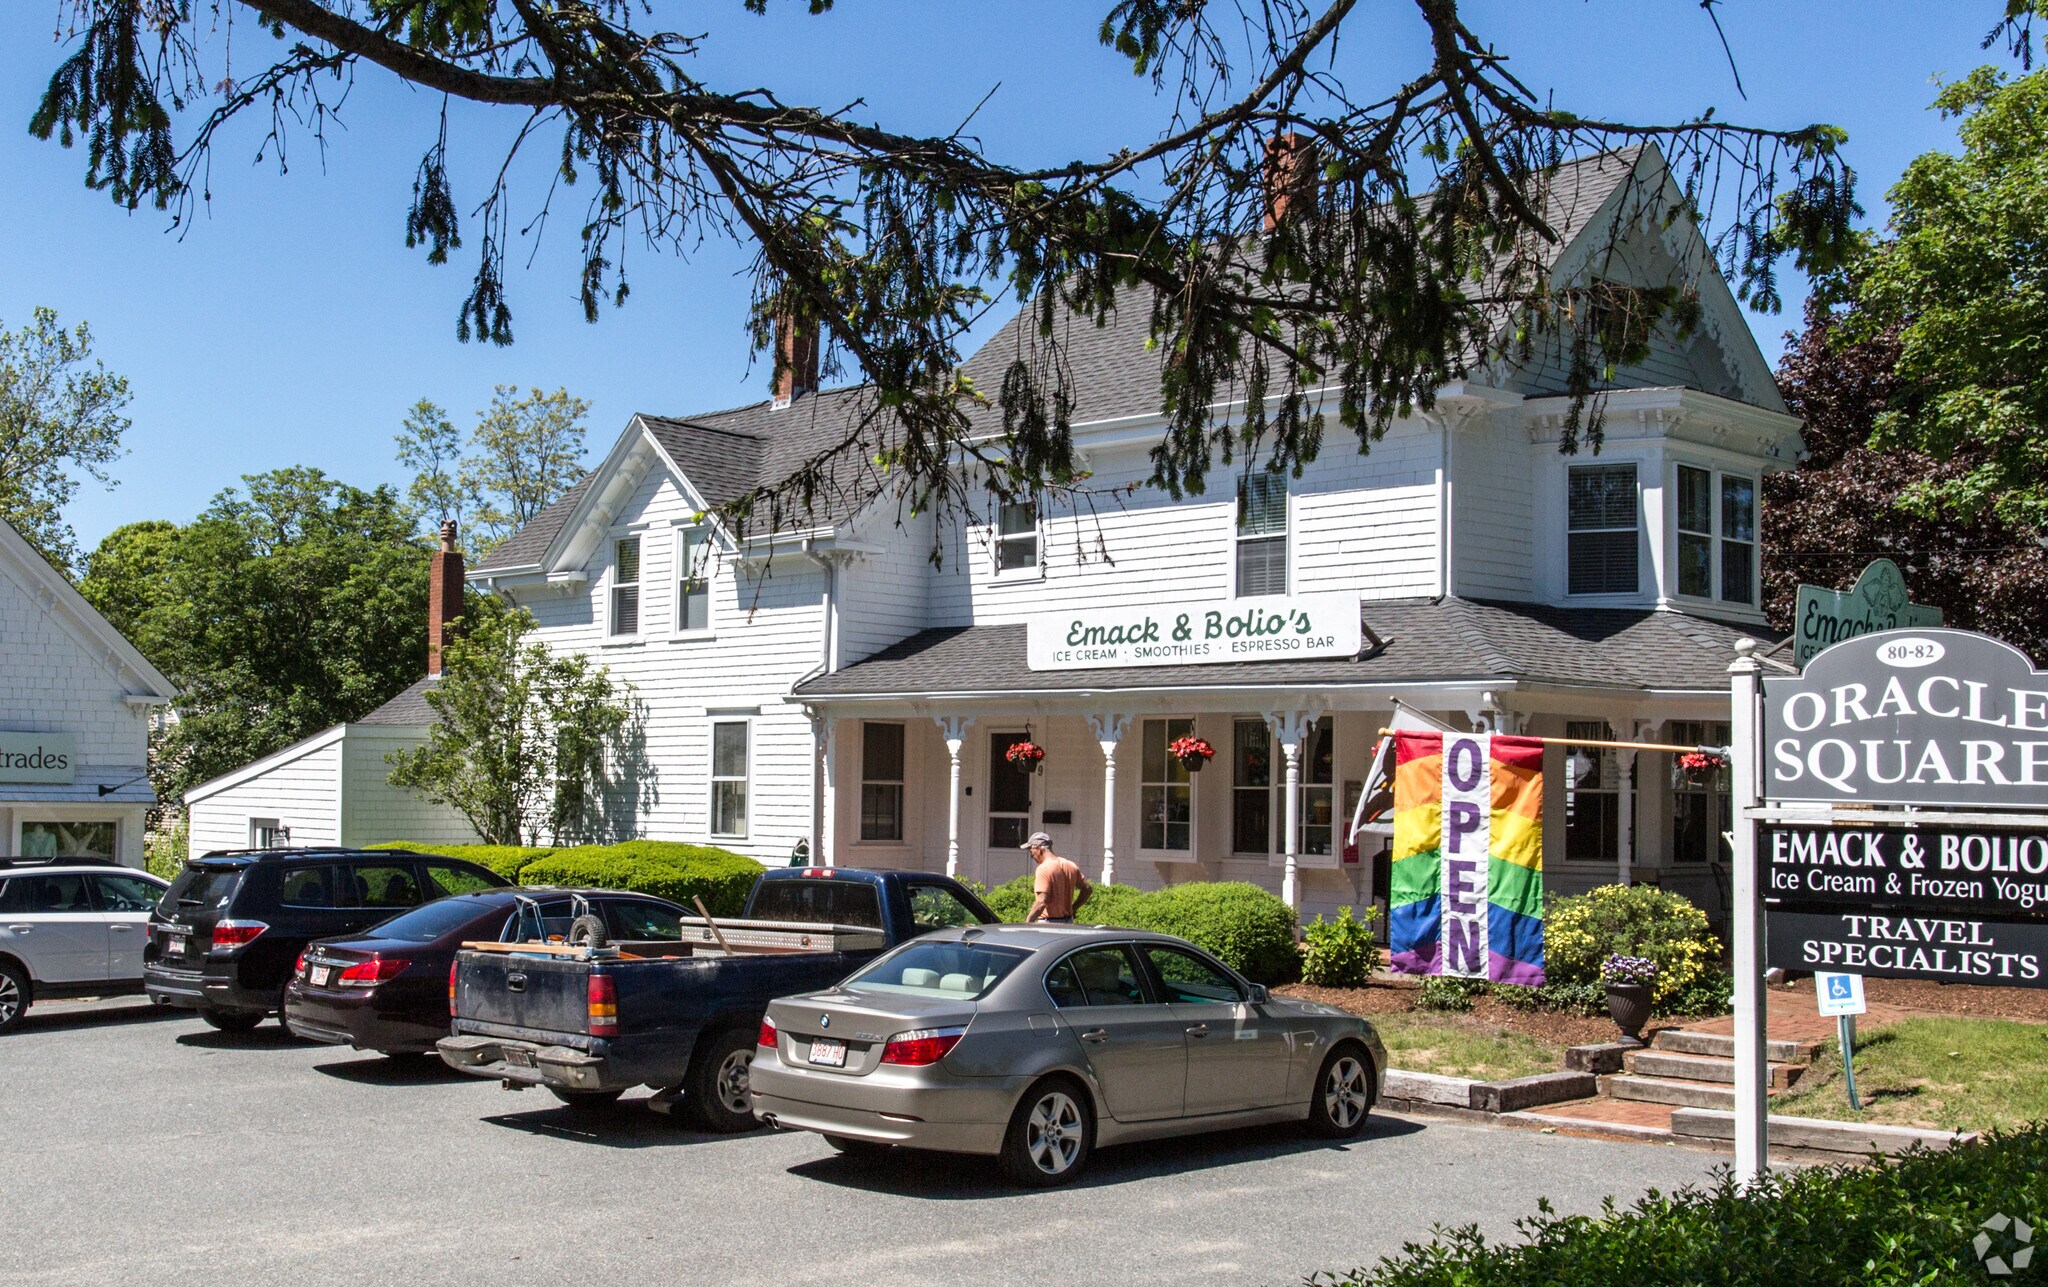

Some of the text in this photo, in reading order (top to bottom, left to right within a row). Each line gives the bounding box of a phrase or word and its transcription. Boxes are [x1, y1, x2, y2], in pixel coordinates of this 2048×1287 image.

[1066, 608, 1313, 647] Emack & Bolio's
[1052, 636, 1335, 662] ICE CREAM SMOOTHIES ESPRESSO BAR
[1887, 644, 1935, 660] 80-82
[1783, 675, 2048, 732] ORACLE
[1774, 738, 2048, 794] SQUARE
[1447, 738, 1483, 973] OPEN
[1772, 829, 1886, 867] EMACK
[1900, 833, 1926, 869] &
[1771, 867, 2048, 908] Ice Cream & Frozen Yogu
[1841, 914, 1994, 946] TRAVEL
[1803, 940, 2040, 979] SPECIALISTS
